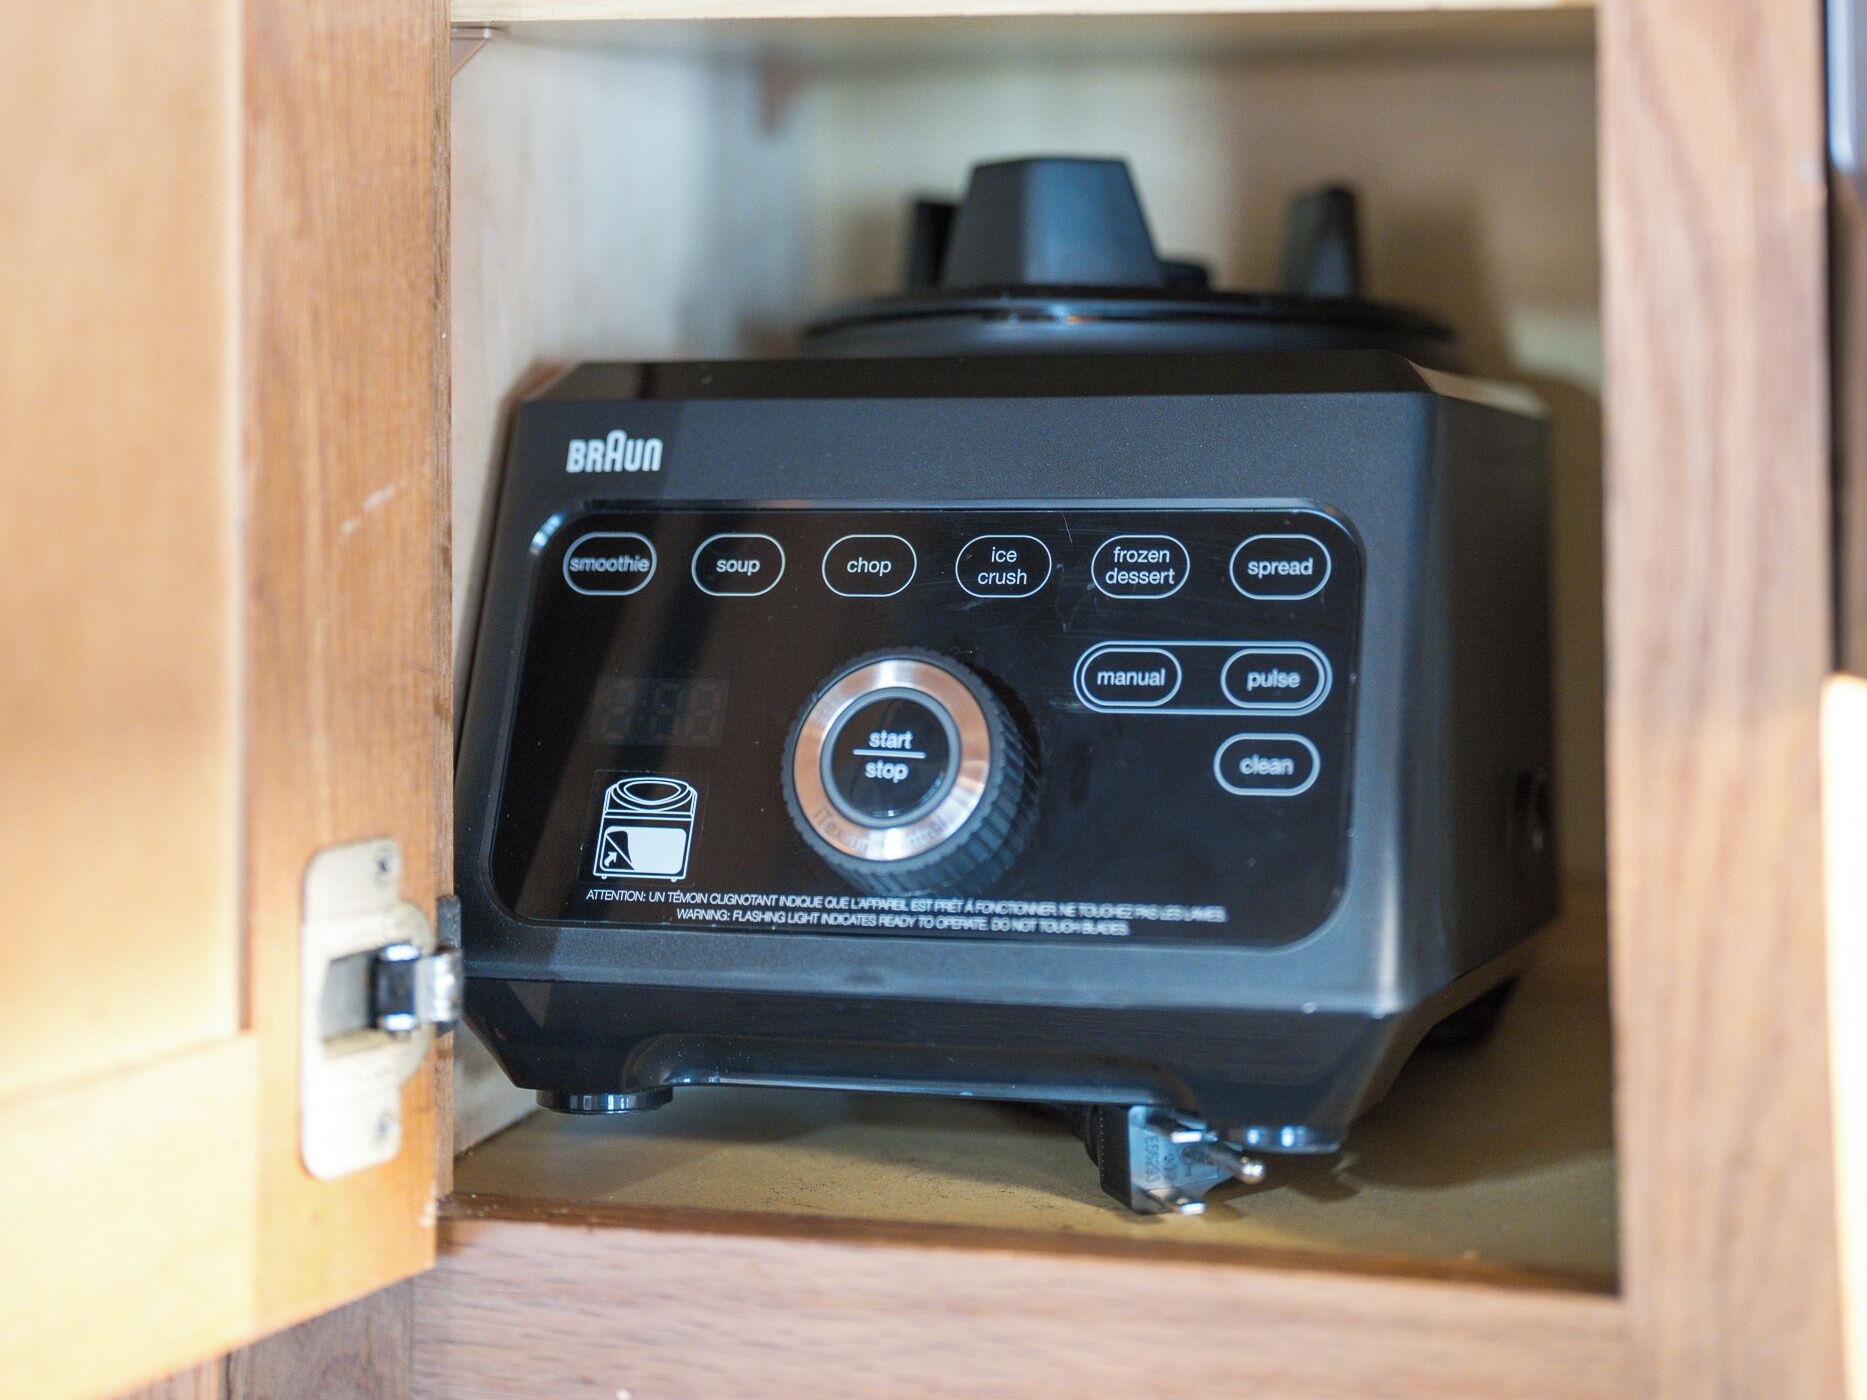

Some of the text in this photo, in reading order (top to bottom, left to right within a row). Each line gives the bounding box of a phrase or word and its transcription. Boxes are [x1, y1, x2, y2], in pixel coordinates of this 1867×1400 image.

[566, 429, 663, 473] BRAUN
[569, 554, 650, 574] smoothie
[990, 546, 1017, 563] ice
[1113, 546, 1170, 564] frozen
[716, 557, 760, 577] soup
[847, 556, 892, 577] chop
[1105, 567, 1175, 586] dessert
[1247, 557, 1314, 579] spread
[977, 568, 1028, 586] crush
[1097, 668, 1166, 688] manual
[1246, 668, 1301, 690] pulse
[868, 730, 914, 750] start
[865, 760, 910, 784] stop
[1239, 755, 1295, 777] clean
[586, 889, 646, 902] ATTENTION:
[648, 892, 665, 903] UN
[667, 890, 707, 904] TÉMOIN
[709, 893, 779, 906] CLIGNOTANT
[779, 895, 823, 909] INDIQUE
[824, 896, 849, 910] QUE
[911, 899, 934, 912] EST
[676, 908, 731, 921] WARNING:
[732, 910, 786, 923] FLASHING
[787, 911, 819, 925] LIGHT
[821, 913, 877, 927] INDICATES
[878, 915, 916, 928] READY
[918, 916, 934, 929] TO
[990, 917, 1011, 932] DO
[1011, 918, 1038, 933] NOT
